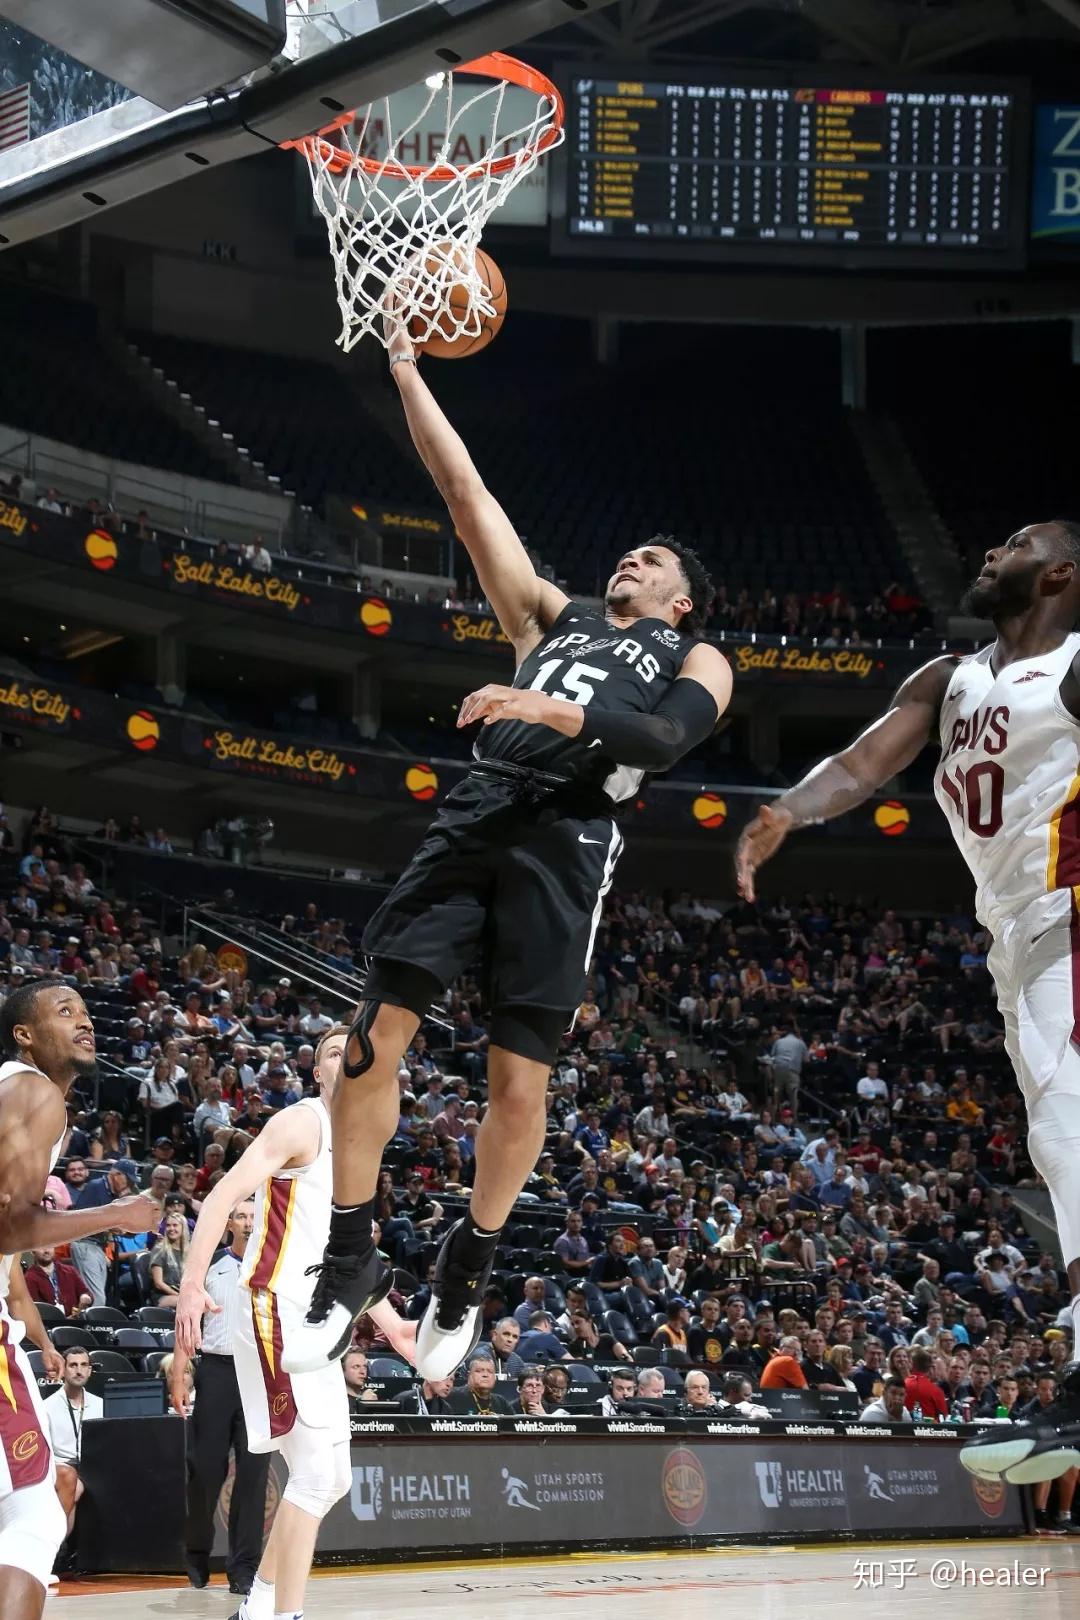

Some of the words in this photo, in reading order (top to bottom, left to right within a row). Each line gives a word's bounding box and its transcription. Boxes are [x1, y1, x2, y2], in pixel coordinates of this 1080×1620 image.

[0, 503, 27, 536] ity
[174, 554, 214, 583] Salt
[215, 565, 263, 597] Lake
[264, 576, 301, 611] City
[452, 614, 495, 642] Salt
[650, 629, 680, 651] Frost
[735, 645, 780, 673] Salt
[780, 647, 832, 672] Lake
[832, 650, 873, 679] City
[531, 658, 610, 706] 15
[0, 682, 30, 710] ake
[30, 687, 71, 725] City
[943, 706, 1010, 762] AVS
[215, 731, 257, 760] Salt
[257, 740, 306, 769] Lake
[307, 748, 345, 781] City
[390, 1474, 470, 1502] HEALTH
[535, 1474, 562, 1486] UTAH
[566, 1472, 604, 1485] SPORTS
[787, 1470, 844, 1492] HEALTH
[887, 1470, 907, 1481] UTAH
[910, 1470, 937, 1481] SPORTS
[535, 1489, 604, 1503] COMMISSION
[889, 1484, 939, 1496] COMMISSION
[392, 1509, 437, 1520] UNIVERSITY
[438, 1508, 449, 1518] OF
[450, 1507, 471, 1518] UTAH
